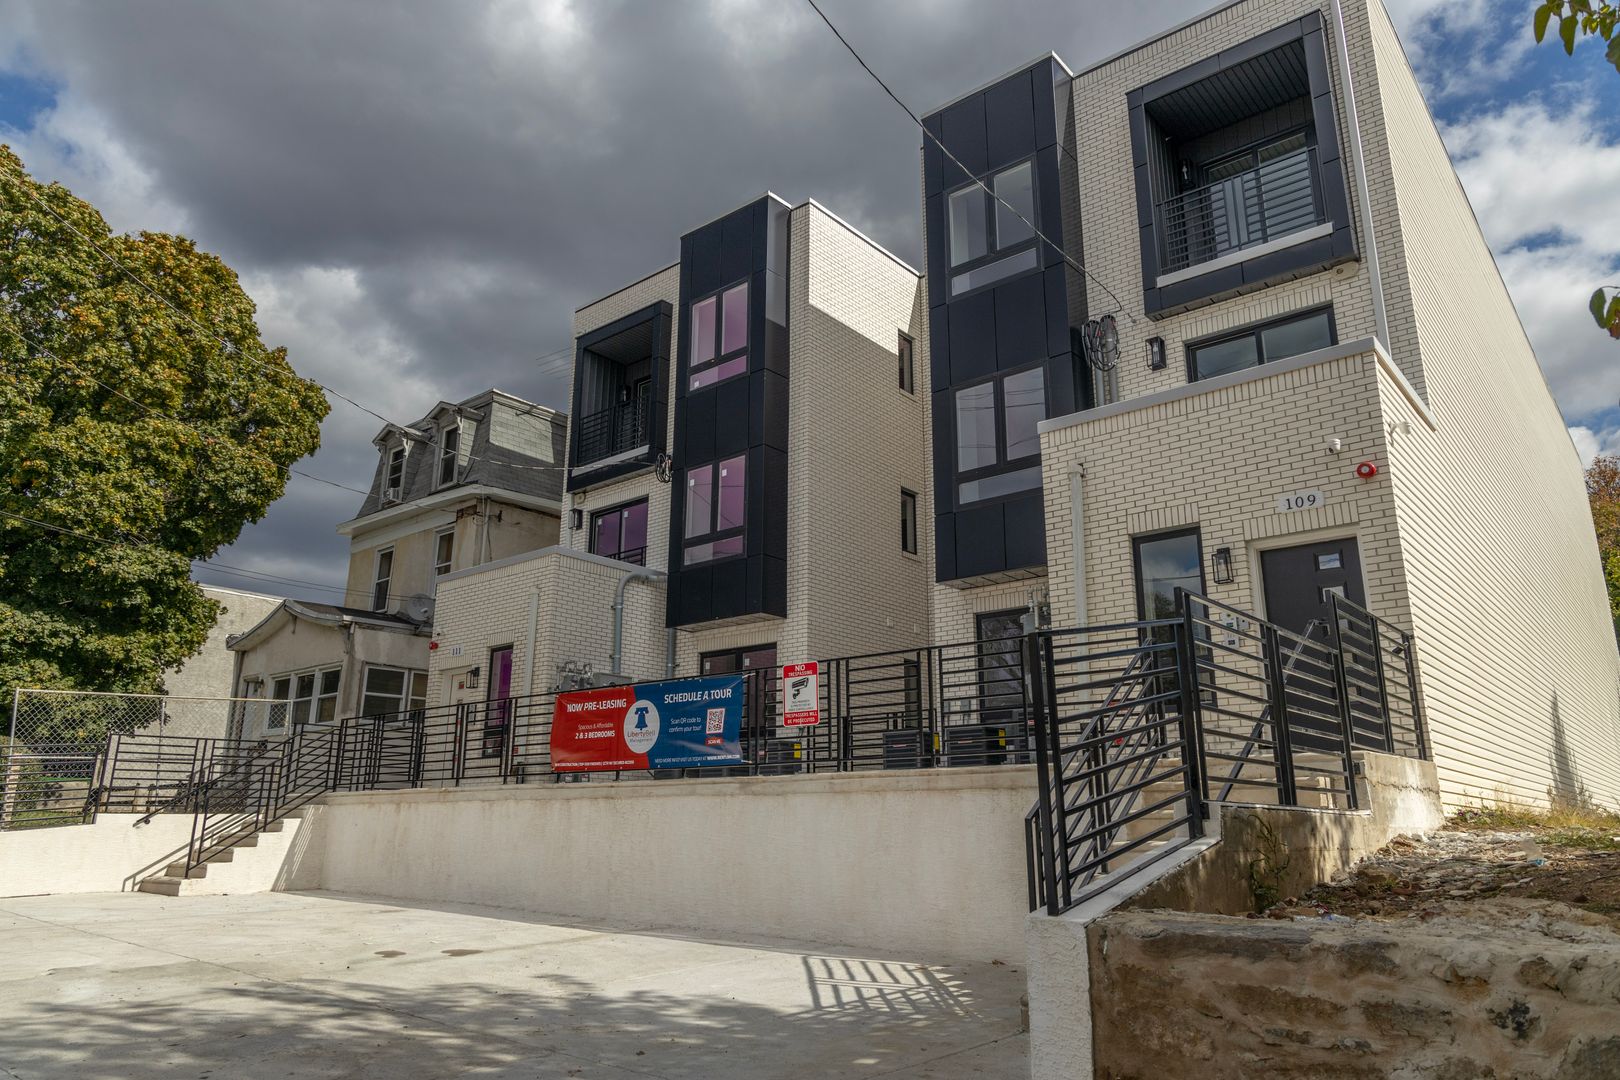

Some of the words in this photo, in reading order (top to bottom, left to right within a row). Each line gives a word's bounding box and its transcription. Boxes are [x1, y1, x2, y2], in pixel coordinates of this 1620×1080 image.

[1286, 495, 1315, 510] 109
[664, 691, 702, 704] SCHEDULE
[703, 691, 708, 700] A
[710, 688, 732, 699] TOUR
[567, 704, 584, 712] NOW
[584, 699, 626, 710] PRE-LEASING
